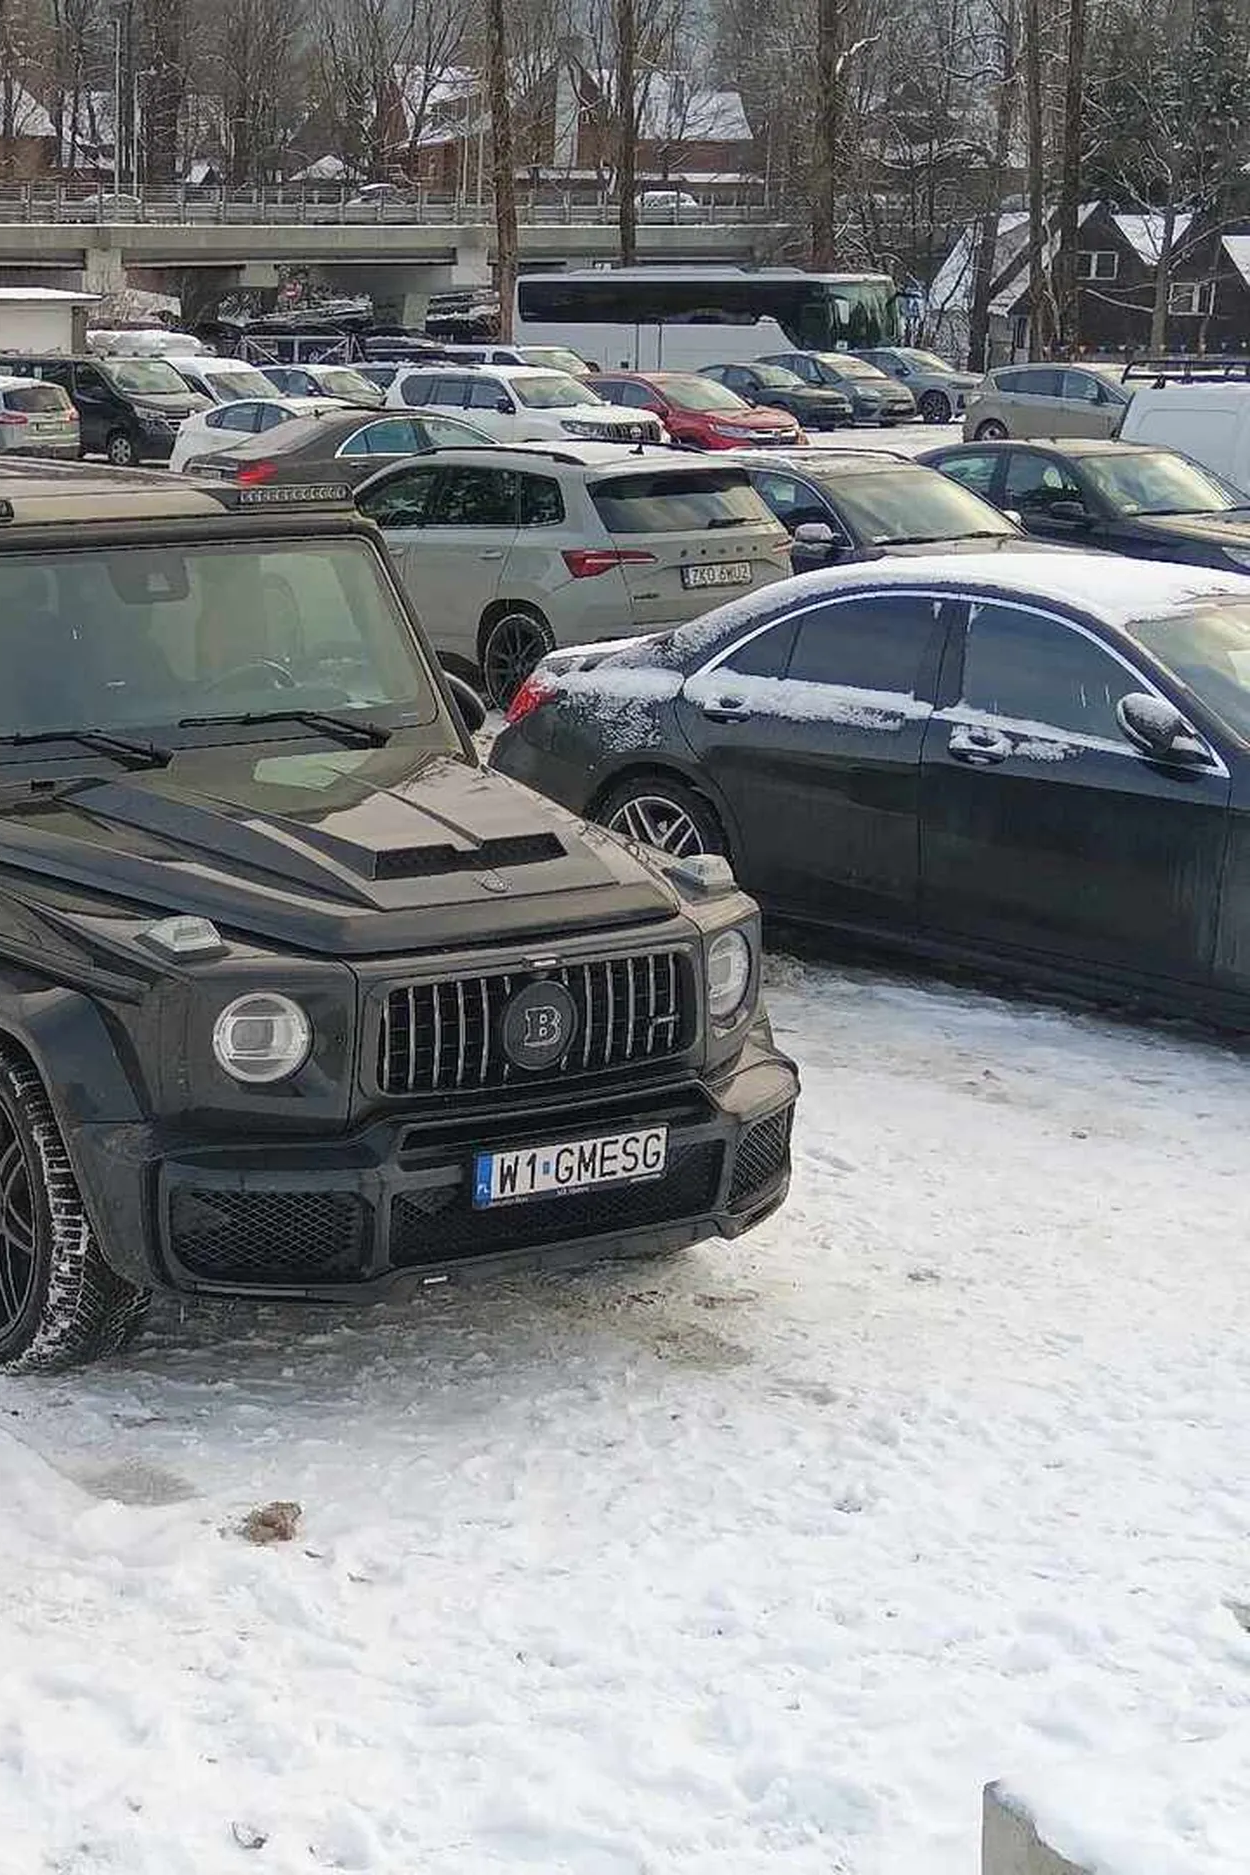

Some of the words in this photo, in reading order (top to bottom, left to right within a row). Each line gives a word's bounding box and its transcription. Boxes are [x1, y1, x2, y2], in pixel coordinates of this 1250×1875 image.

[524, 1006, 561, 1047] B
[499, 1152, 538, 1194] W1
[554, 1133, 661, 1184] GMESG
